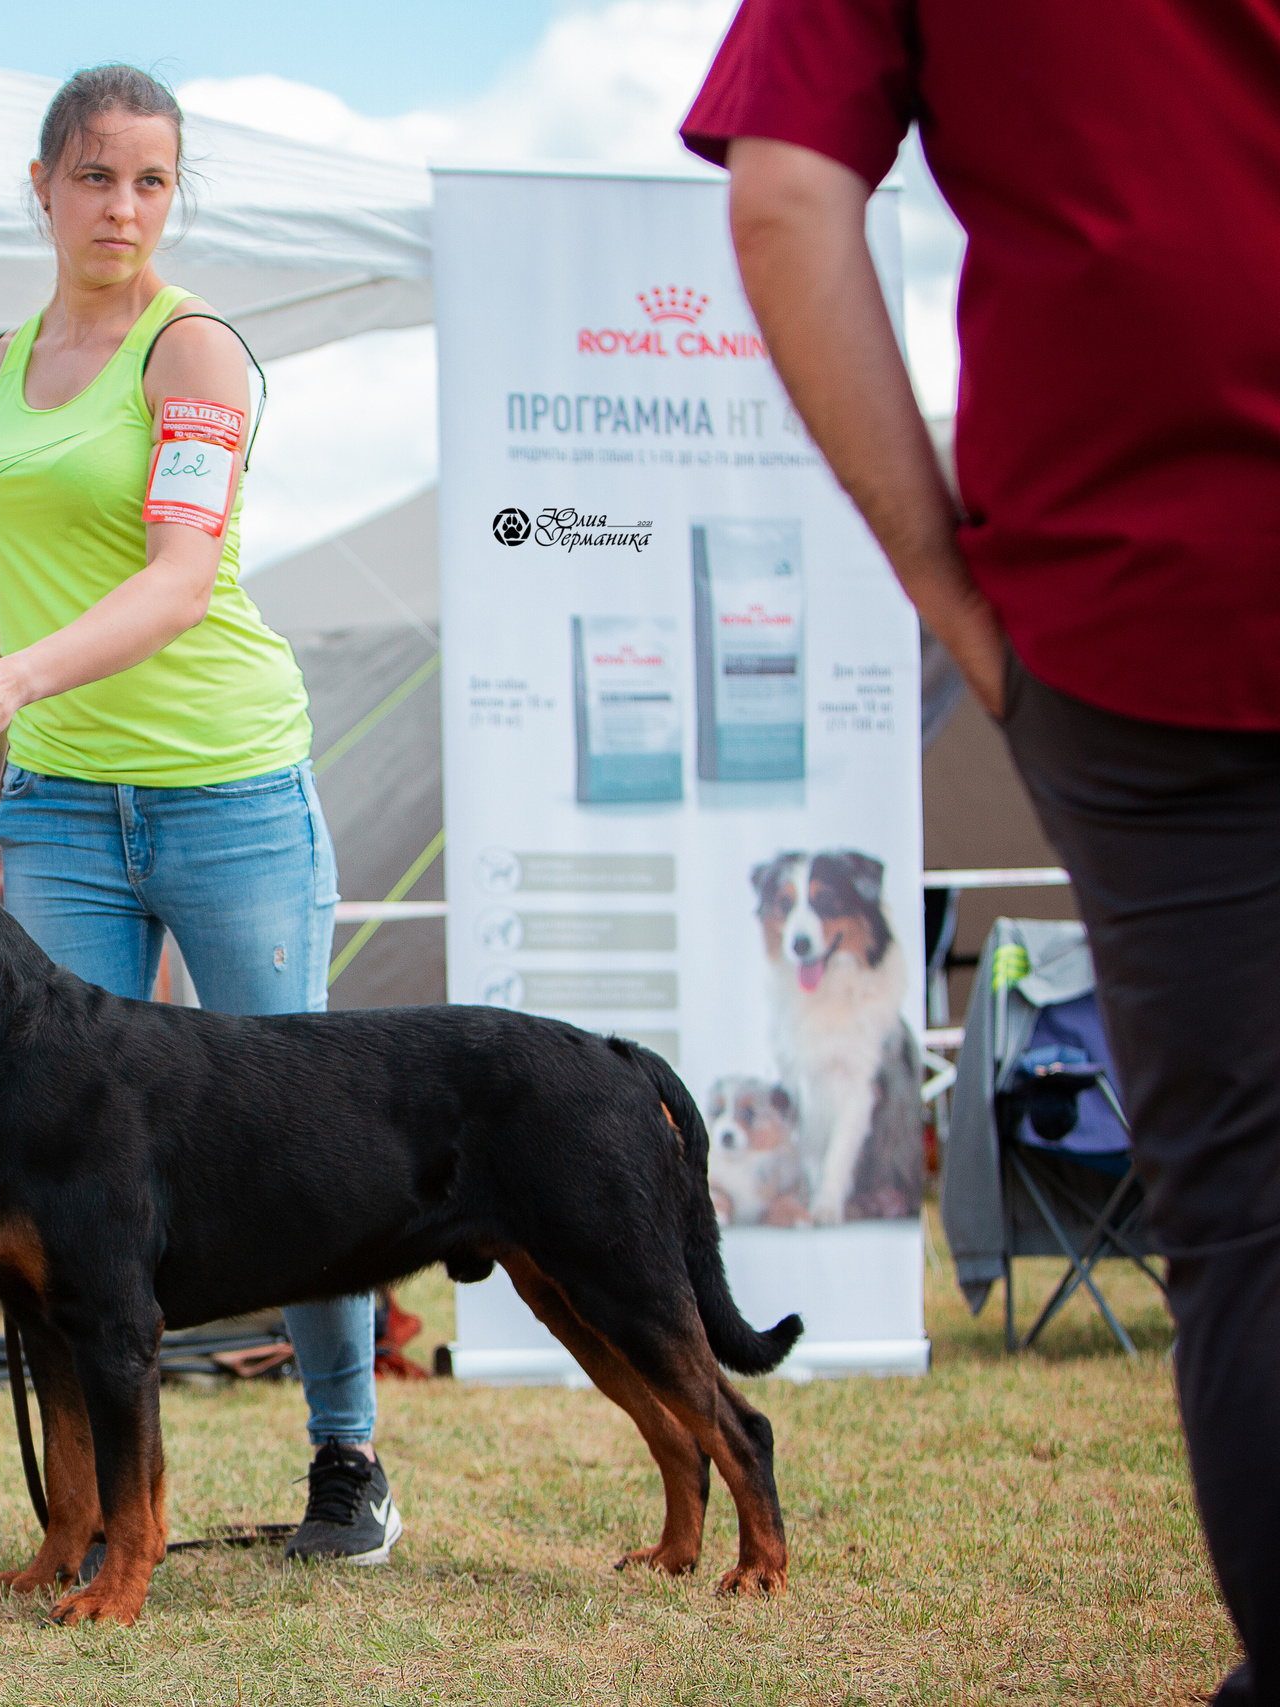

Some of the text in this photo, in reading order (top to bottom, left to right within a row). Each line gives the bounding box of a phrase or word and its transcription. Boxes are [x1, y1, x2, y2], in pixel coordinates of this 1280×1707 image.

[578, 329, 769, 359] ROYAL CANIN
[168, 405, 239, 431] ТРАПЕЗА
[507, 393, 714, 436] ПРОГРАММА
[161, 451, 211, 477] 22
